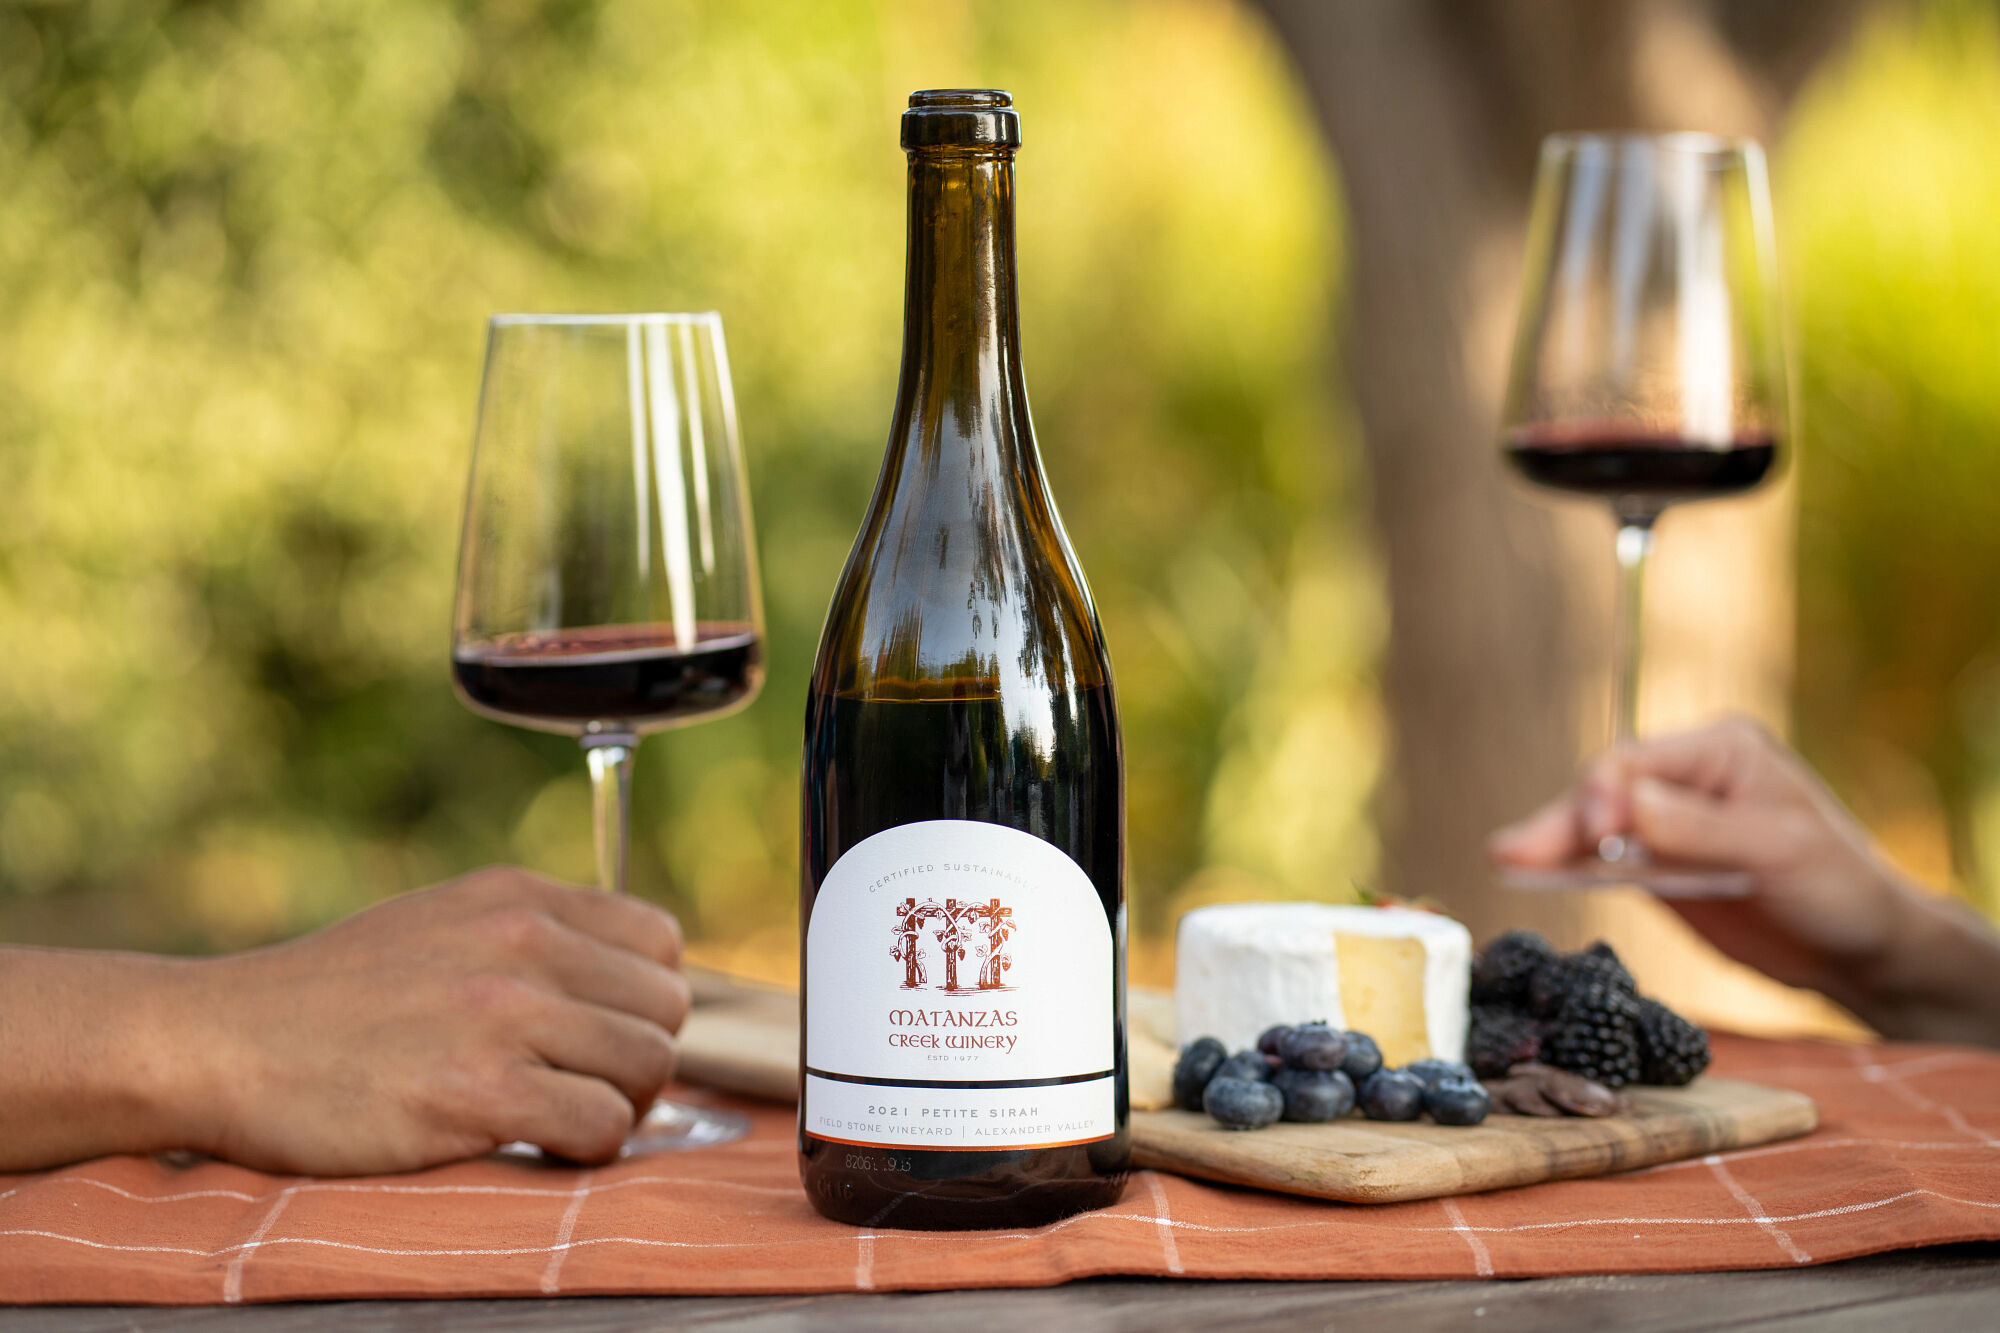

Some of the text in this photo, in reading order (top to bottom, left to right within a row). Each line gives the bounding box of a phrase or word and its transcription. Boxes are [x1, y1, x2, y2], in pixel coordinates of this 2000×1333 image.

[869, 864, 934, 893] CERTIFIED
[889, 1009, 1018, 1027] MATANZAS
[888, 1033, 1018, 1055] CREEK WINERY
[868, 1105, 1039, 1118] 2021 PETITE SIRAH
[819, 1116, 1095, 1136] FIELD STONE VINEYARD ALEXANDER VALLEY
